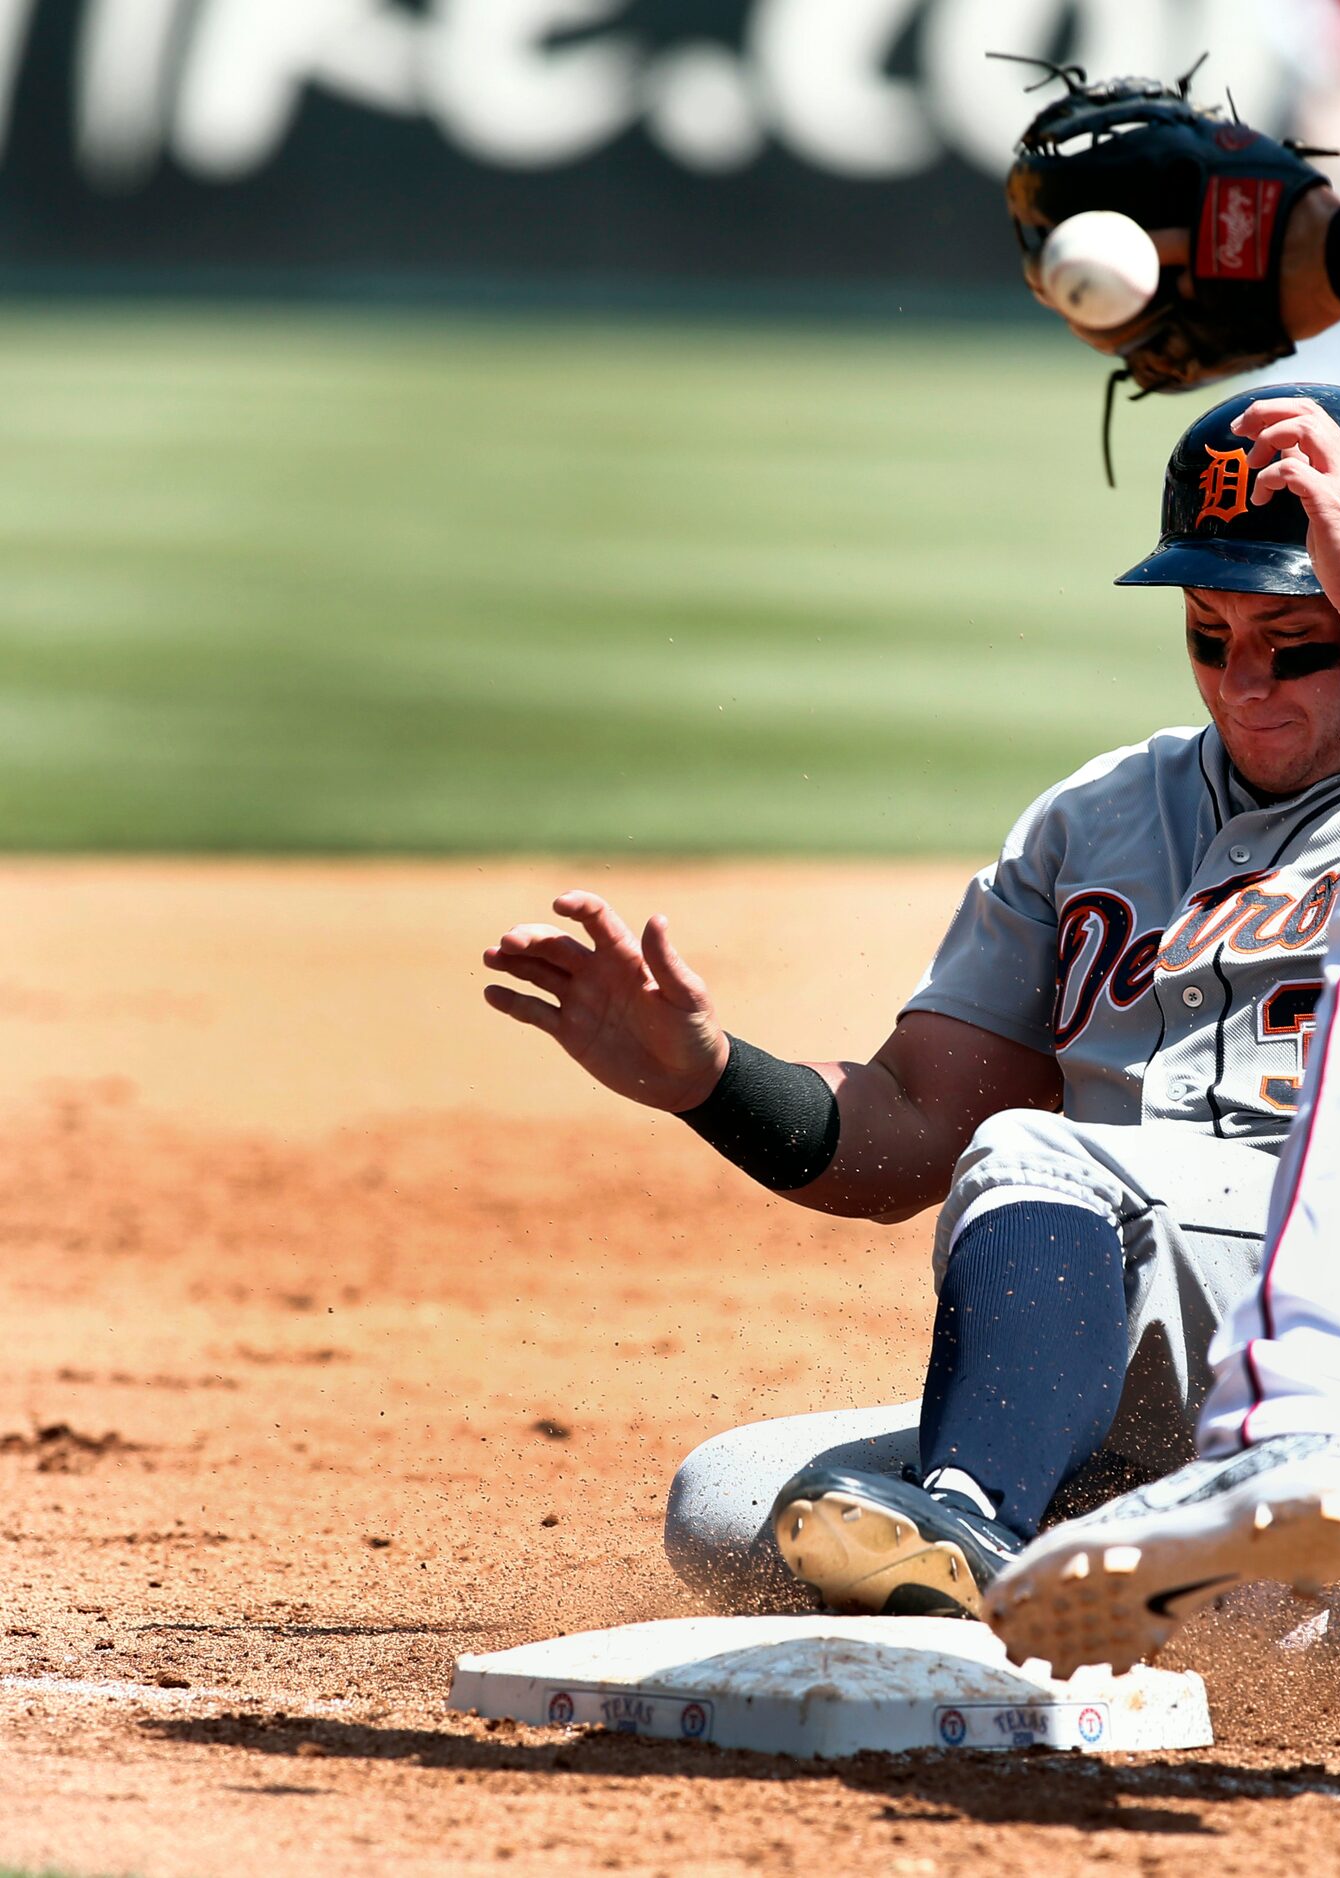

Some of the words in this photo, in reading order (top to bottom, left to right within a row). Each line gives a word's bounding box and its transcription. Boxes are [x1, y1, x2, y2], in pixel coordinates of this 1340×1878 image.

[1196, 443, 1249, 528] D
[601, 1697, 655, 1724] TEXAS
[994, 1709, 1049, 1734] TEXAS
